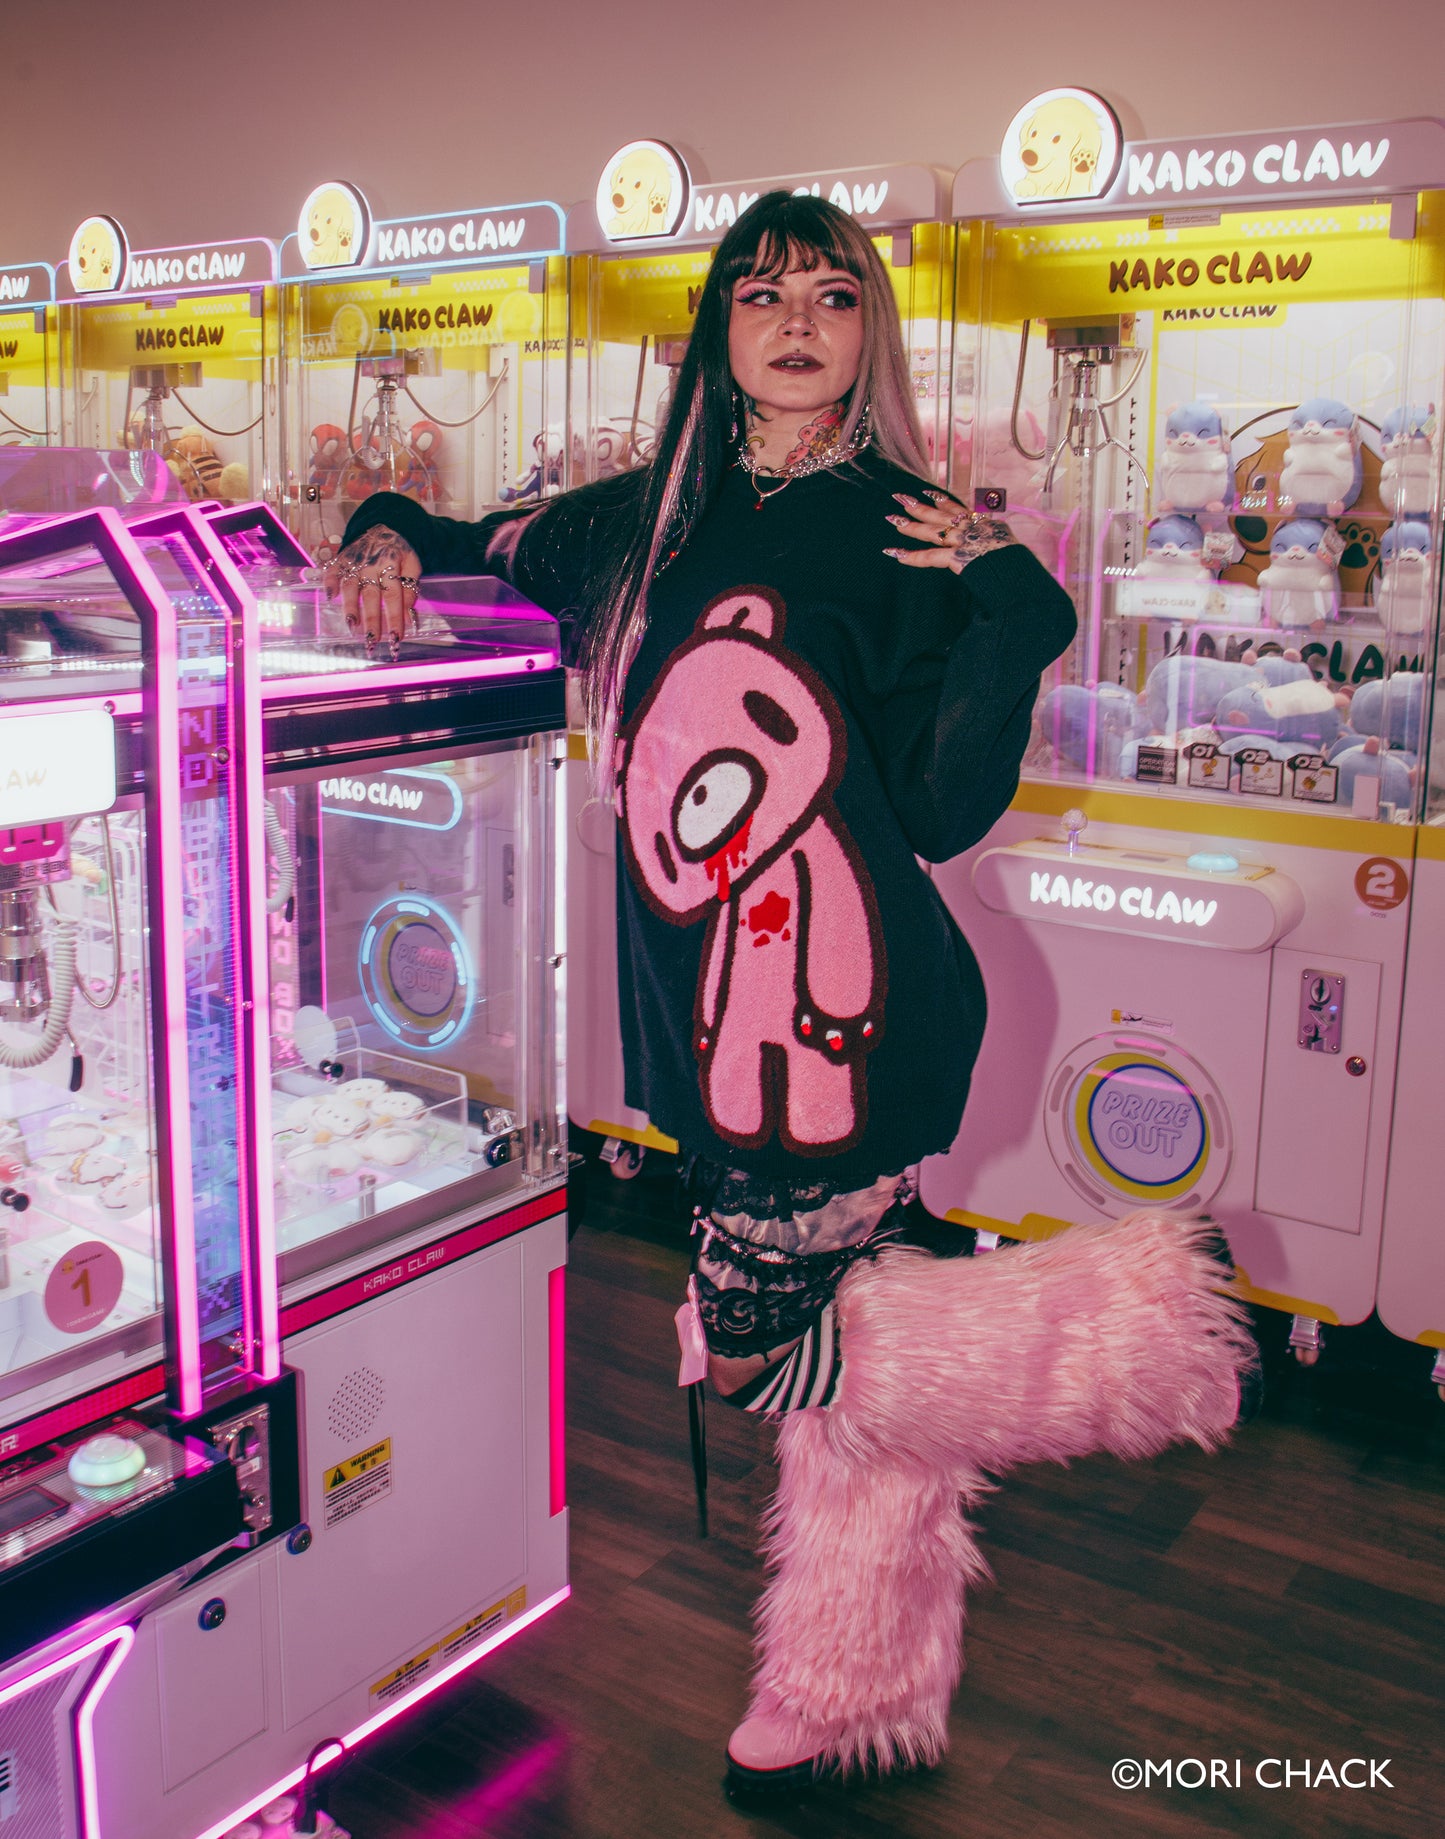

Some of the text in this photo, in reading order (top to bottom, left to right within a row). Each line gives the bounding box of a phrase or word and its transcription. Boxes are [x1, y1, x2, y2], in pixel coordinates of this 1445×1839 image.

[1127, 138, 1390, 196] KAKO CLAW
[378, 218, 526, 262] KAKO CLAW
[131, 251, 246, 288] KAKO CLAW
[1108, 251, 1313, 293] KAKO CLAW
[378, 302, 493, 333] KAKO CLAW
[135, 324, 225, 351] KAKO CLAW
[1192, 744, 1215, 758] 01
[1241, 750, 1269, 764] 02
[367, 782, 423, 811] CLAW
[1029, 871, 1218, 926] KAKO CLAW
[1365, 863, 1397, 899] 2
[400, 965, 446, 996] OUT
[1102, 1091, 1193, 1129] PRIZE
[1108, 1119, 1183, 1159] OUT
[71, 1267, 92, 1308] 1
[363, 1247, 446, 1293] KAKO CLAW
[350, 1443, 386, 1468] WARNING
